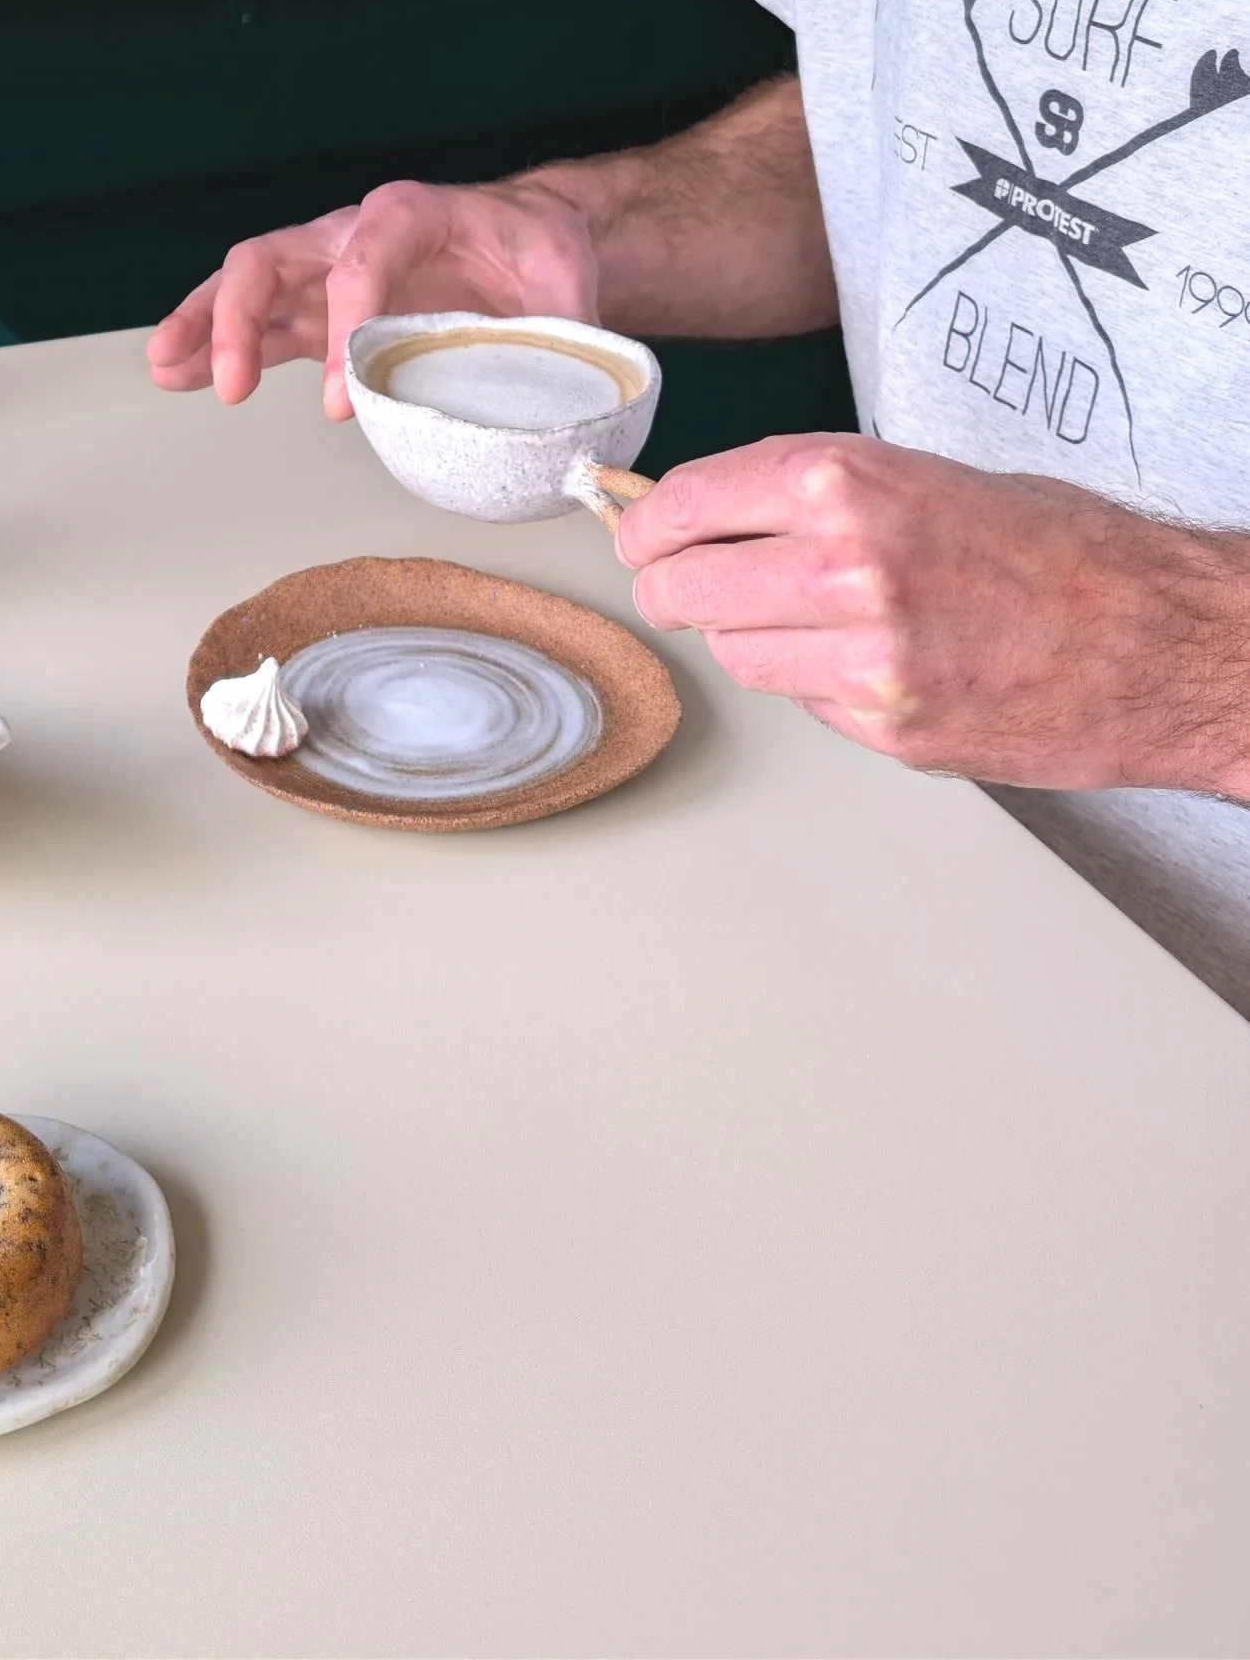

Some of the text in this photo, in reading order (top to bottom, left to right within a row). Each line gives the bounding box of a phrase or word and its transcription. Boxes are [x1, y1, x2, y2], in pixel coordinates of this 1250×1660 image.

[1011, 186, 1097, 245] PROTEST
[1176, 265, 1250, 328] 199
[944, 290, 1100, 444] BLEND
